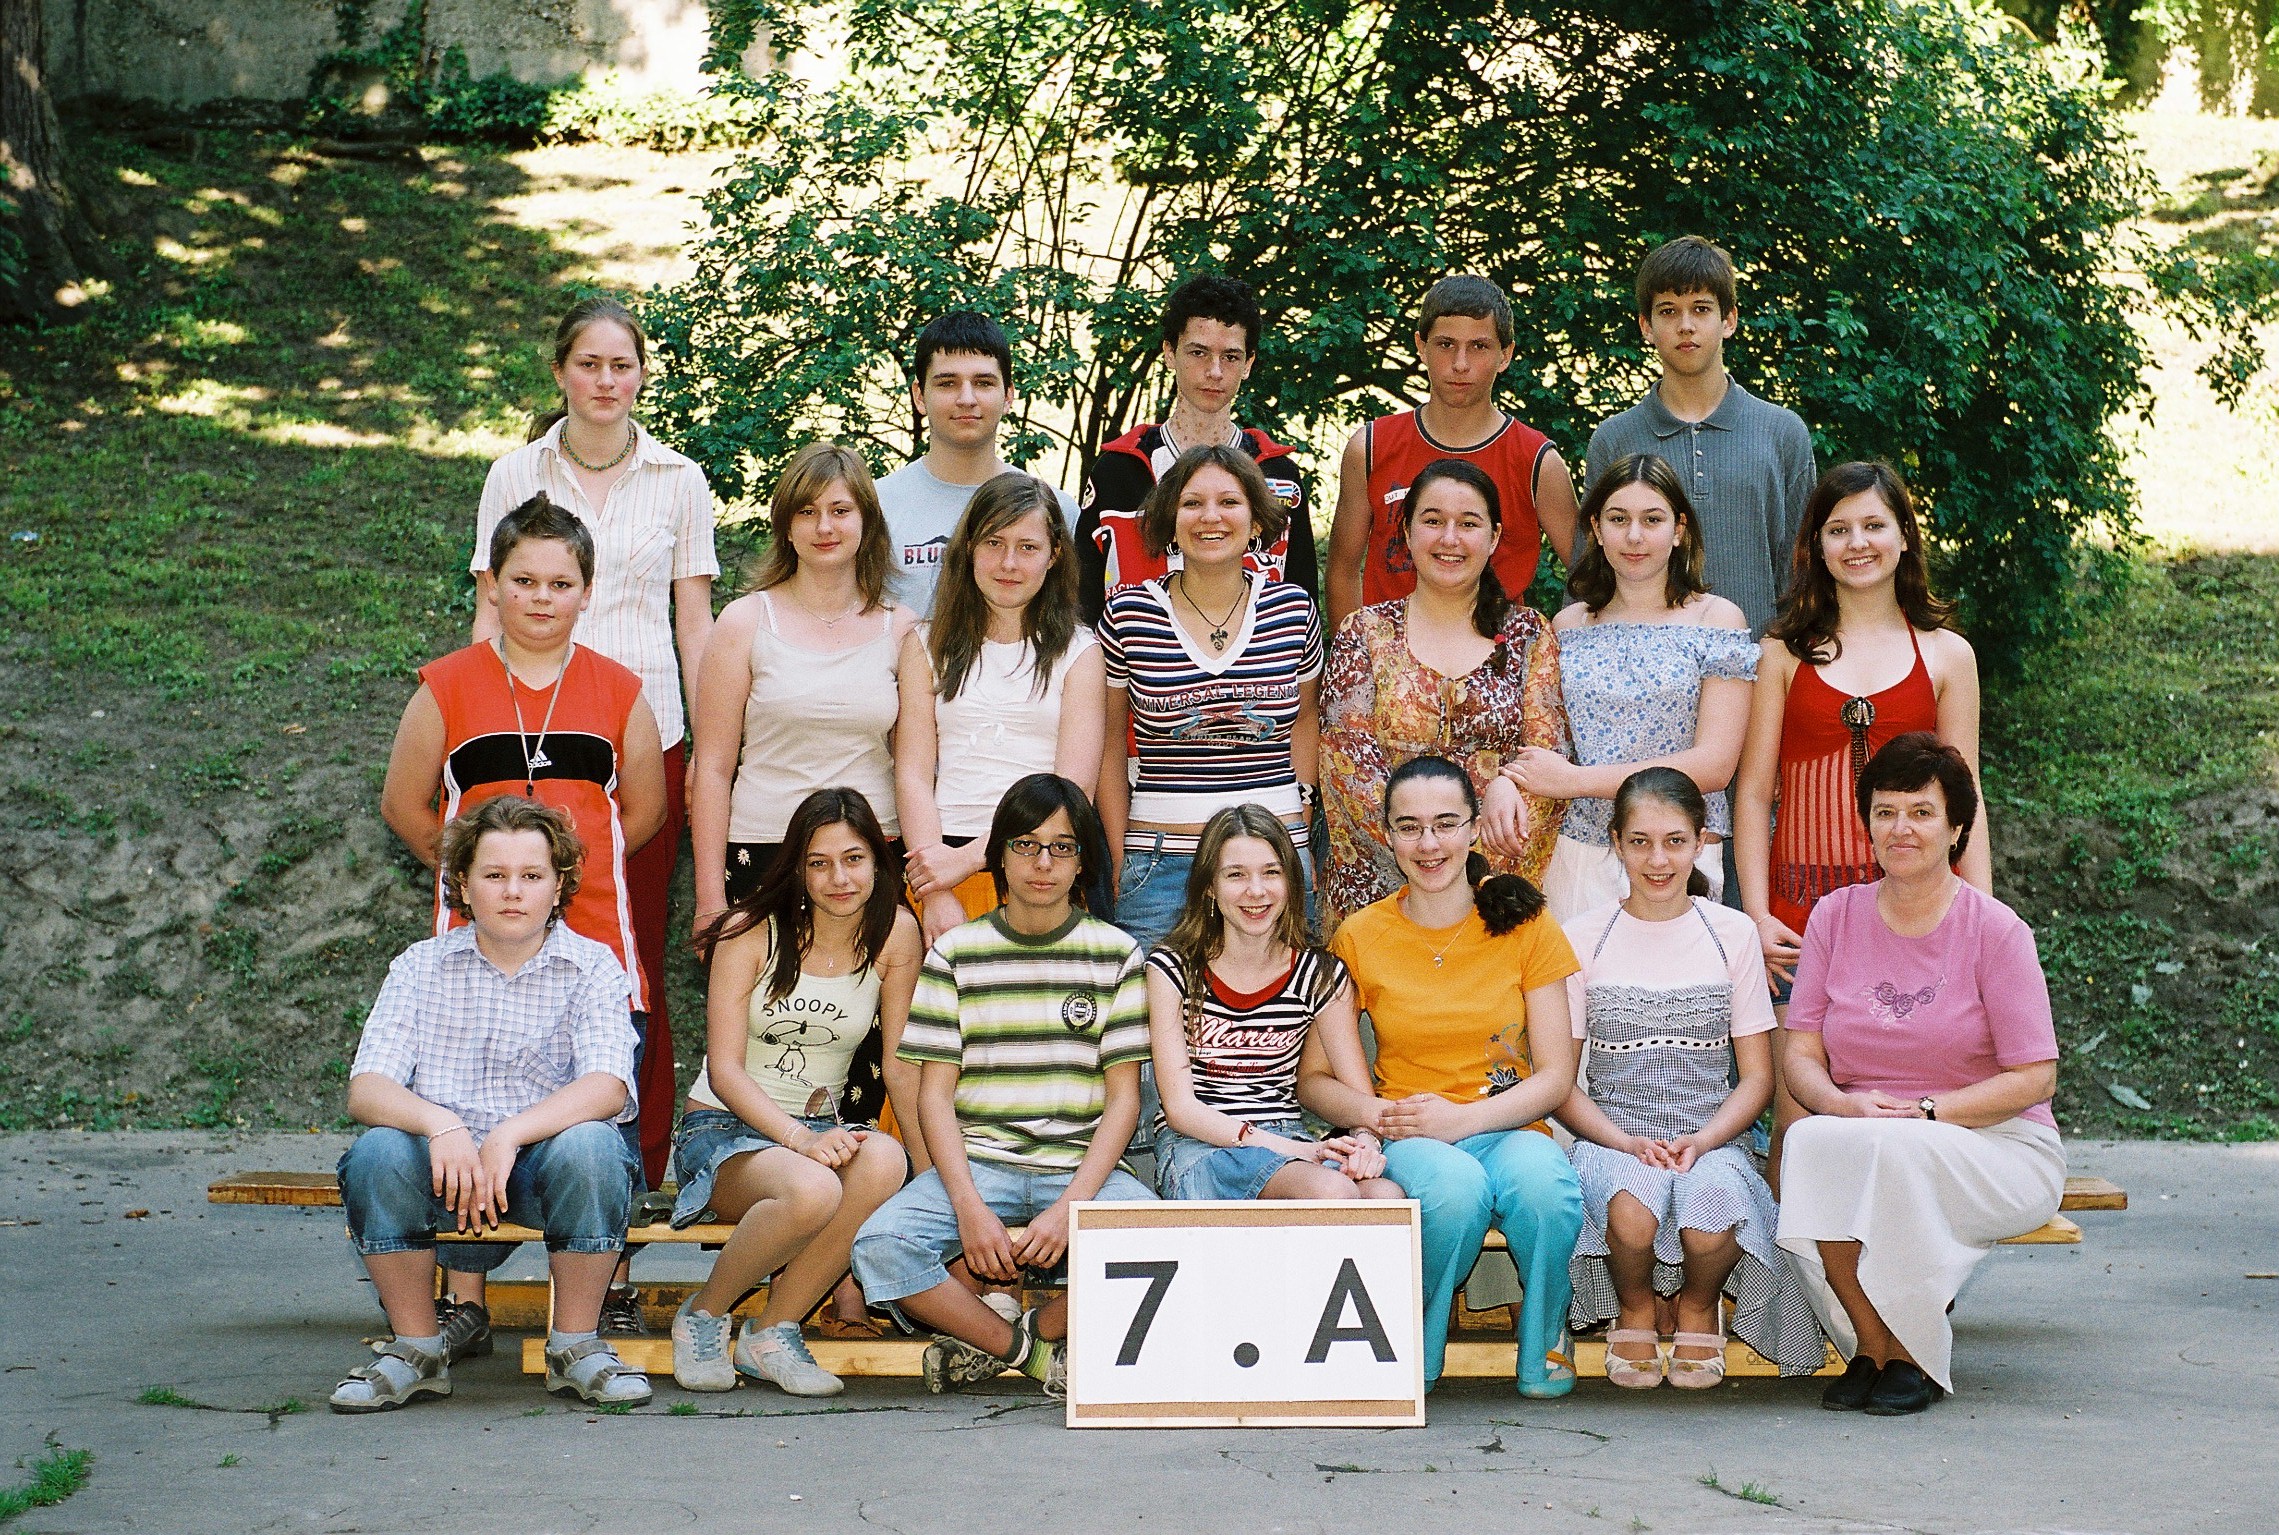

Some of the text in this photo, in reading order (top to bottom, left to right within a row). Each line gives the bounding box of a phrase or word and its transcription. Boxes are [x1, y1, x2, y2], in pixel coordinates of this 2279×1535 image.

[1105, 583, 1142, 601] RACIN
[763, 998, 848, 1021] SNOOPY
[1190, 1015, 1298, 1049] Marine
